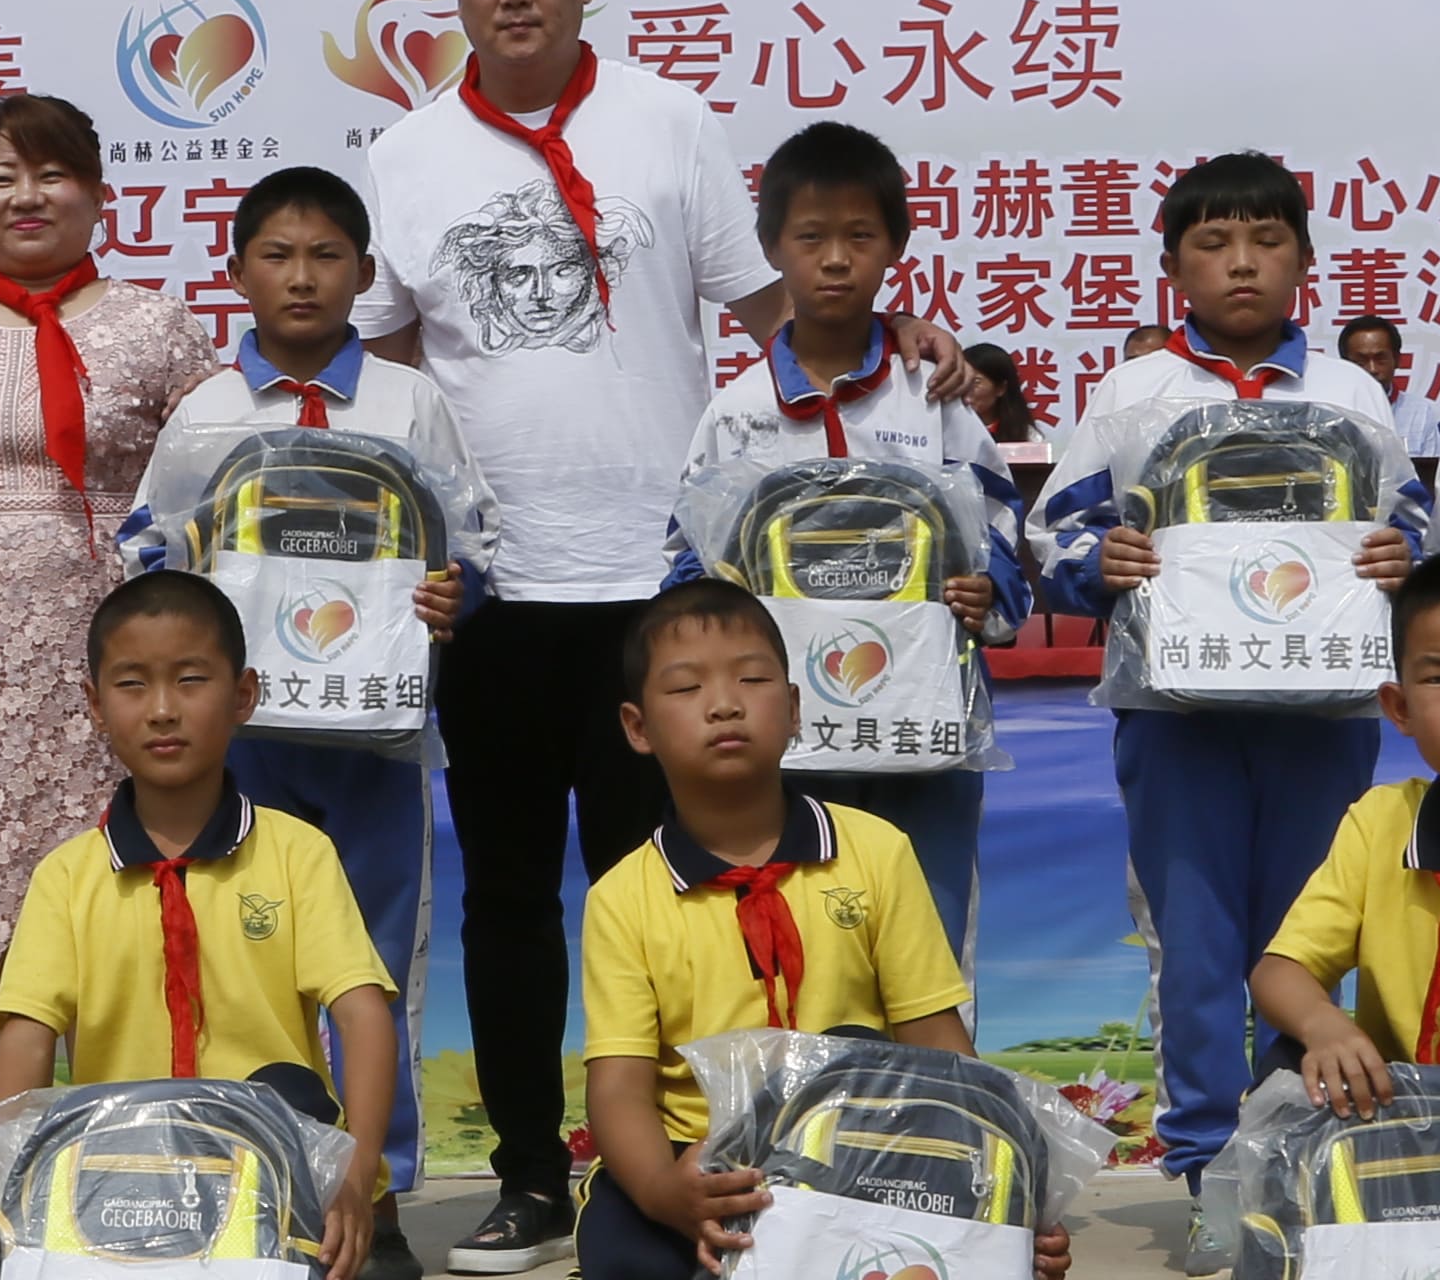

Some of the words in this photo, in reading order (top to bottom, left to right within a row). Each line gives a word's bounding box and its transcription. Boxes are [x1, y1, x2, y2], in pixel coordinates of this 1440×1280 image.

[209, 101, 236, 123] SUN
[234, 67, 264, 103] HOPE
[110, 137, 280, 163] 尚赫公益基金会
[874, 429, 928, 447] YUNDONG
[280, 538, 359, 556] GEGEBAOBEI
[808, 570, 888, 588] GEGEBAOBEI
[1159, 632, 1393, 671] 尚赫文具套组
[789, 714, 963, 756] 文具套组
[101, 1208, 202, 1231] GEGEBAOBEI
